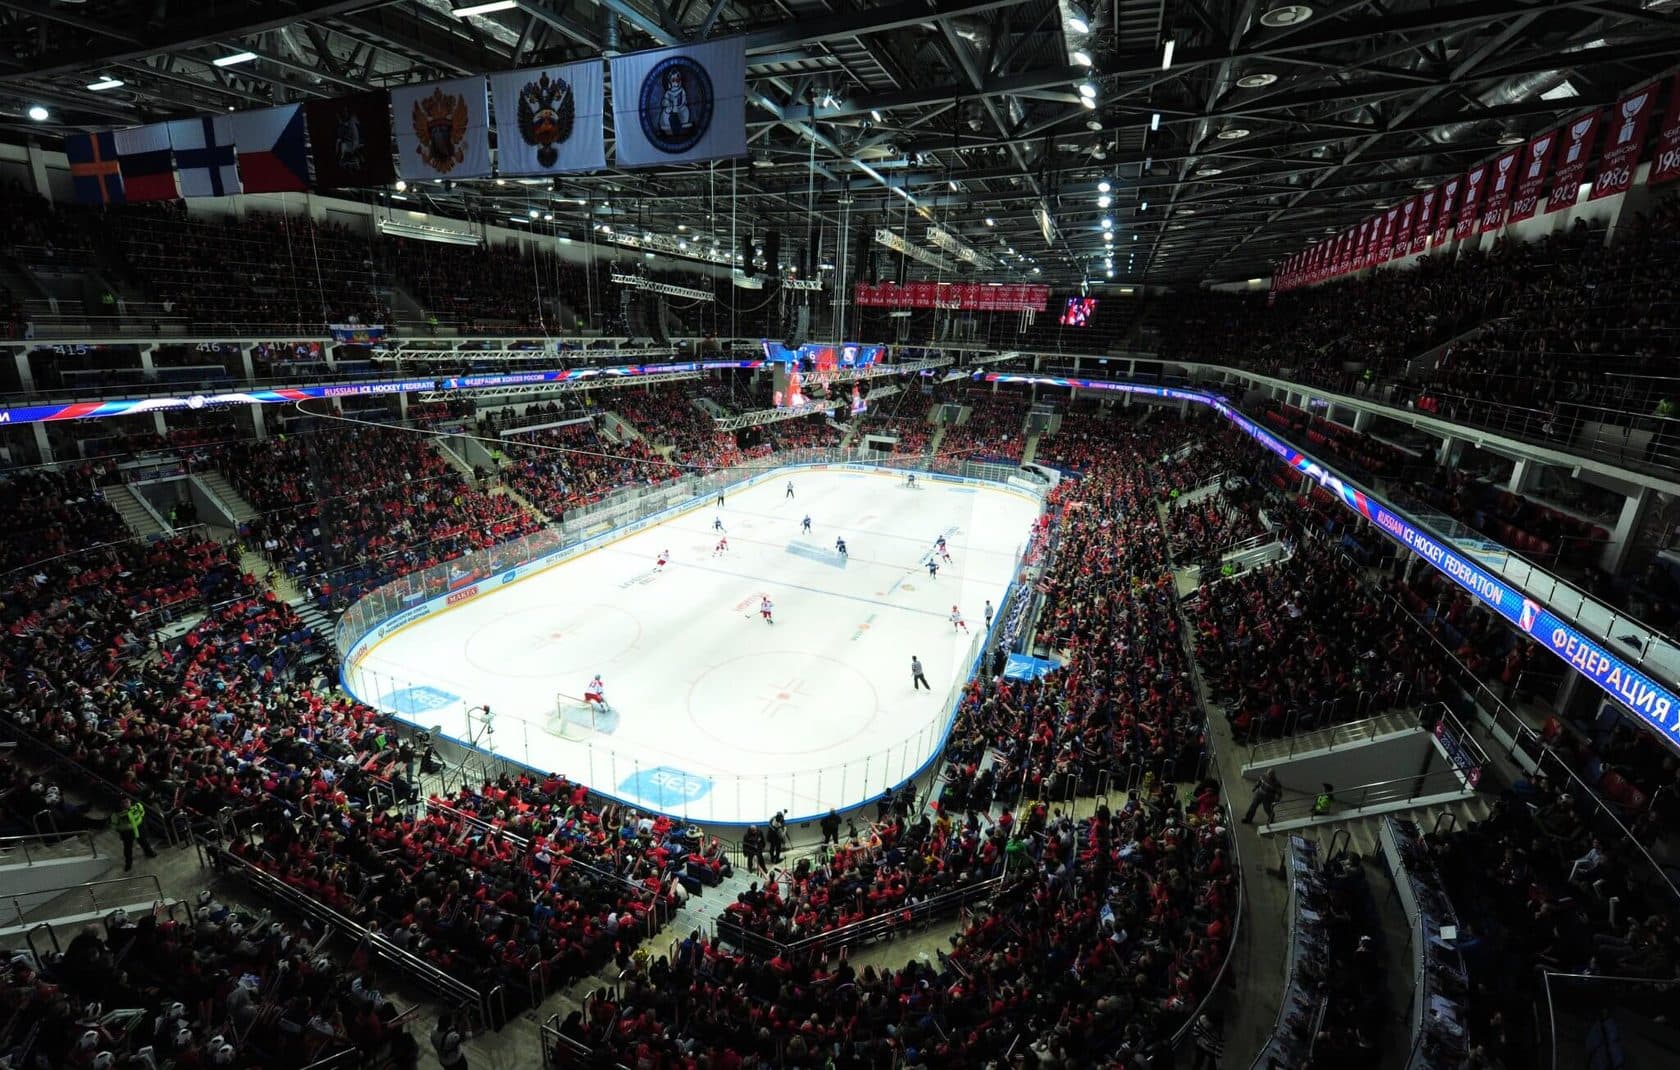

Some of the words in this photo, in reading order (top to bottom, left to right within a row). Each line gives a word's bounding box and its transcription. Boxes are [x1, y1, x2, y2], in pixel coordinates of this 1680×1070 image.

[1596, 166, 1630, 192] 1986
[55, 344, 86, 356] 415
[195, 342, 220, 352] 416
[324, 385, 358, 397] RUSSIAN
[359, 384, 372, 394] ICE
[372, 382, 400, 393] HOCKEY
[1377, 511, 1404, 537] RUSSIAN
[1402, 526, 1415, 545] ICE
[1413, 535, 1444, 564] HOCKEY
[1444, 553, 1504, 605] FEDERATION
[1552, 628, 1671, 723] ФЕДЕРАЦИЯ
